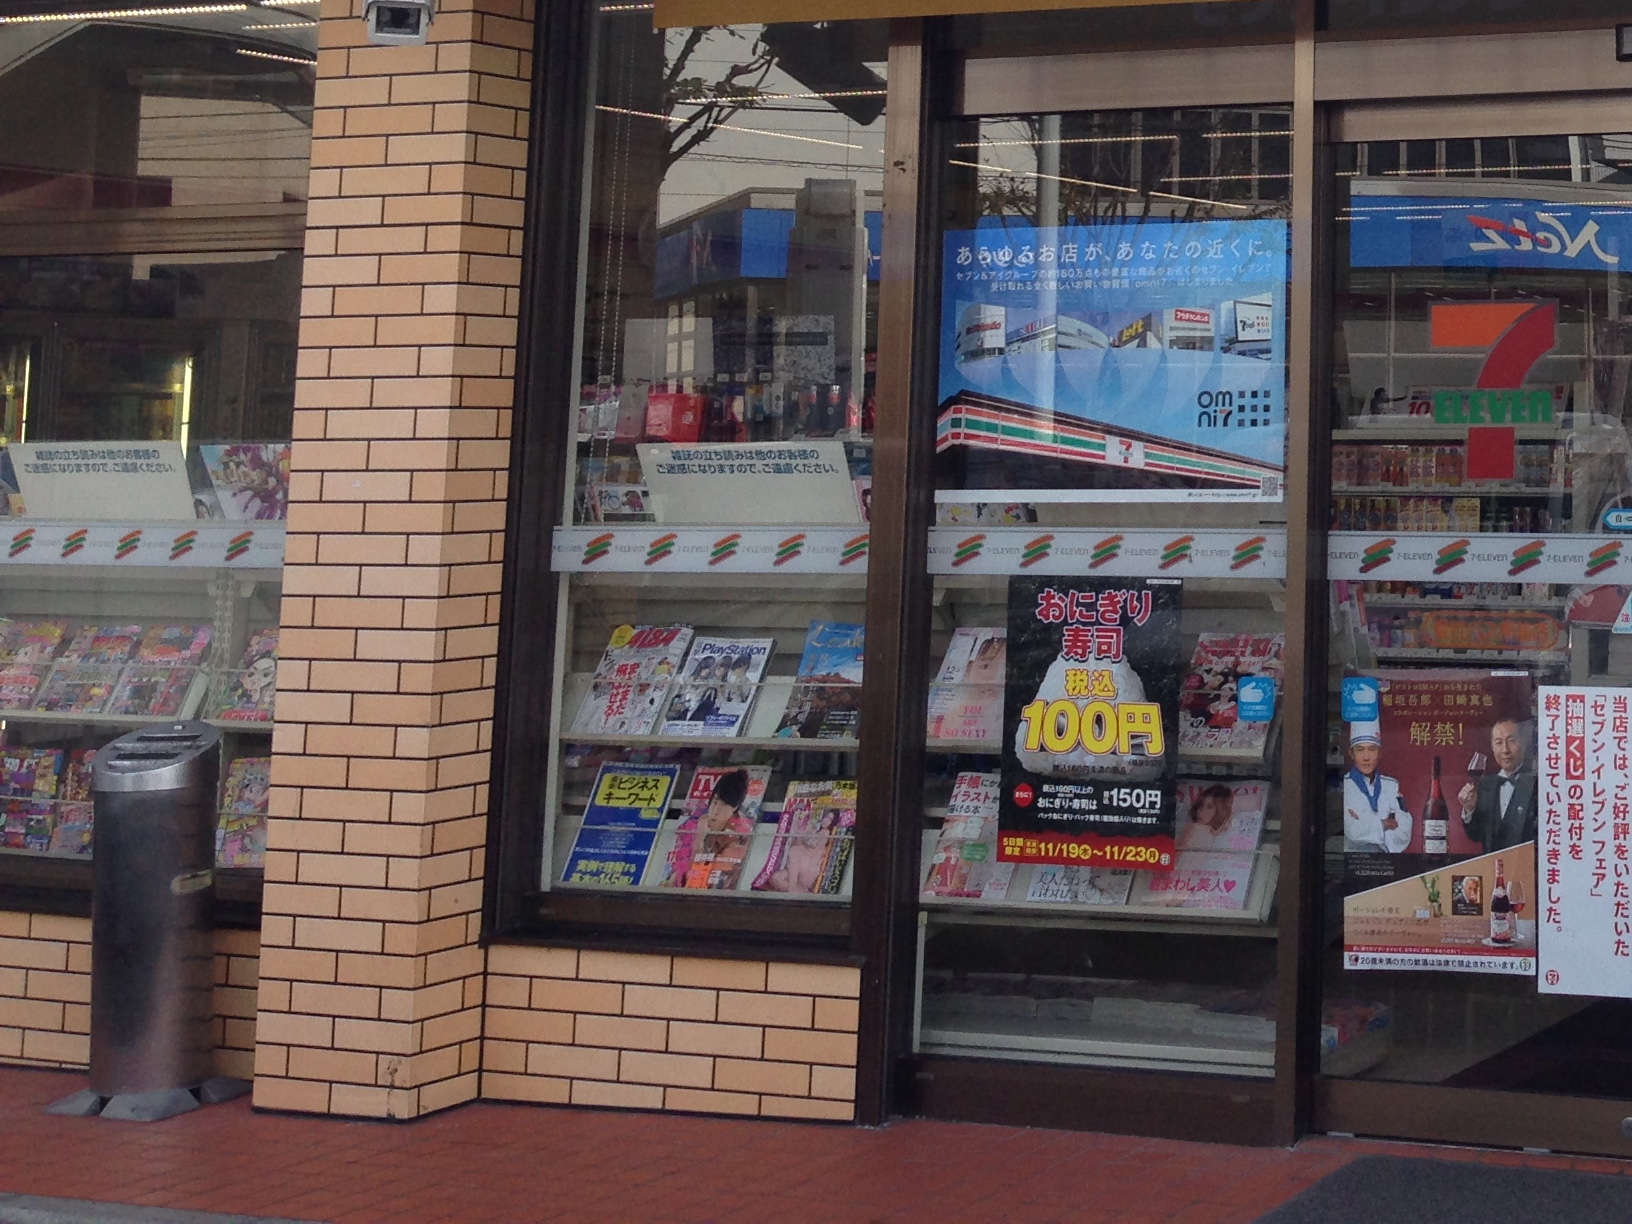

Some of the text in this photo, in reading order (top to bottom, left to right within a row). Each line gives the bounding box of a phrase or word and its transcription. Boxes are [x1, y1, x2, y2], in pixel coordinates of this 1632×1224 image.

[1431, 303, 1557, 479] 7
[1036, 588, 1153, 626] おにぎり
[701, 643, 767, 657] PlayStation
[1062, 626, 1124, 662] 寿司
[1021, 699, 1165, 756] 100円
[1409, 721, 1464, 746] 解禁!
[1545, 693, 1563, 933] 終了させていただきました。
[1612, 695, 1631, 957] 当店では、ご好評をいただいた
